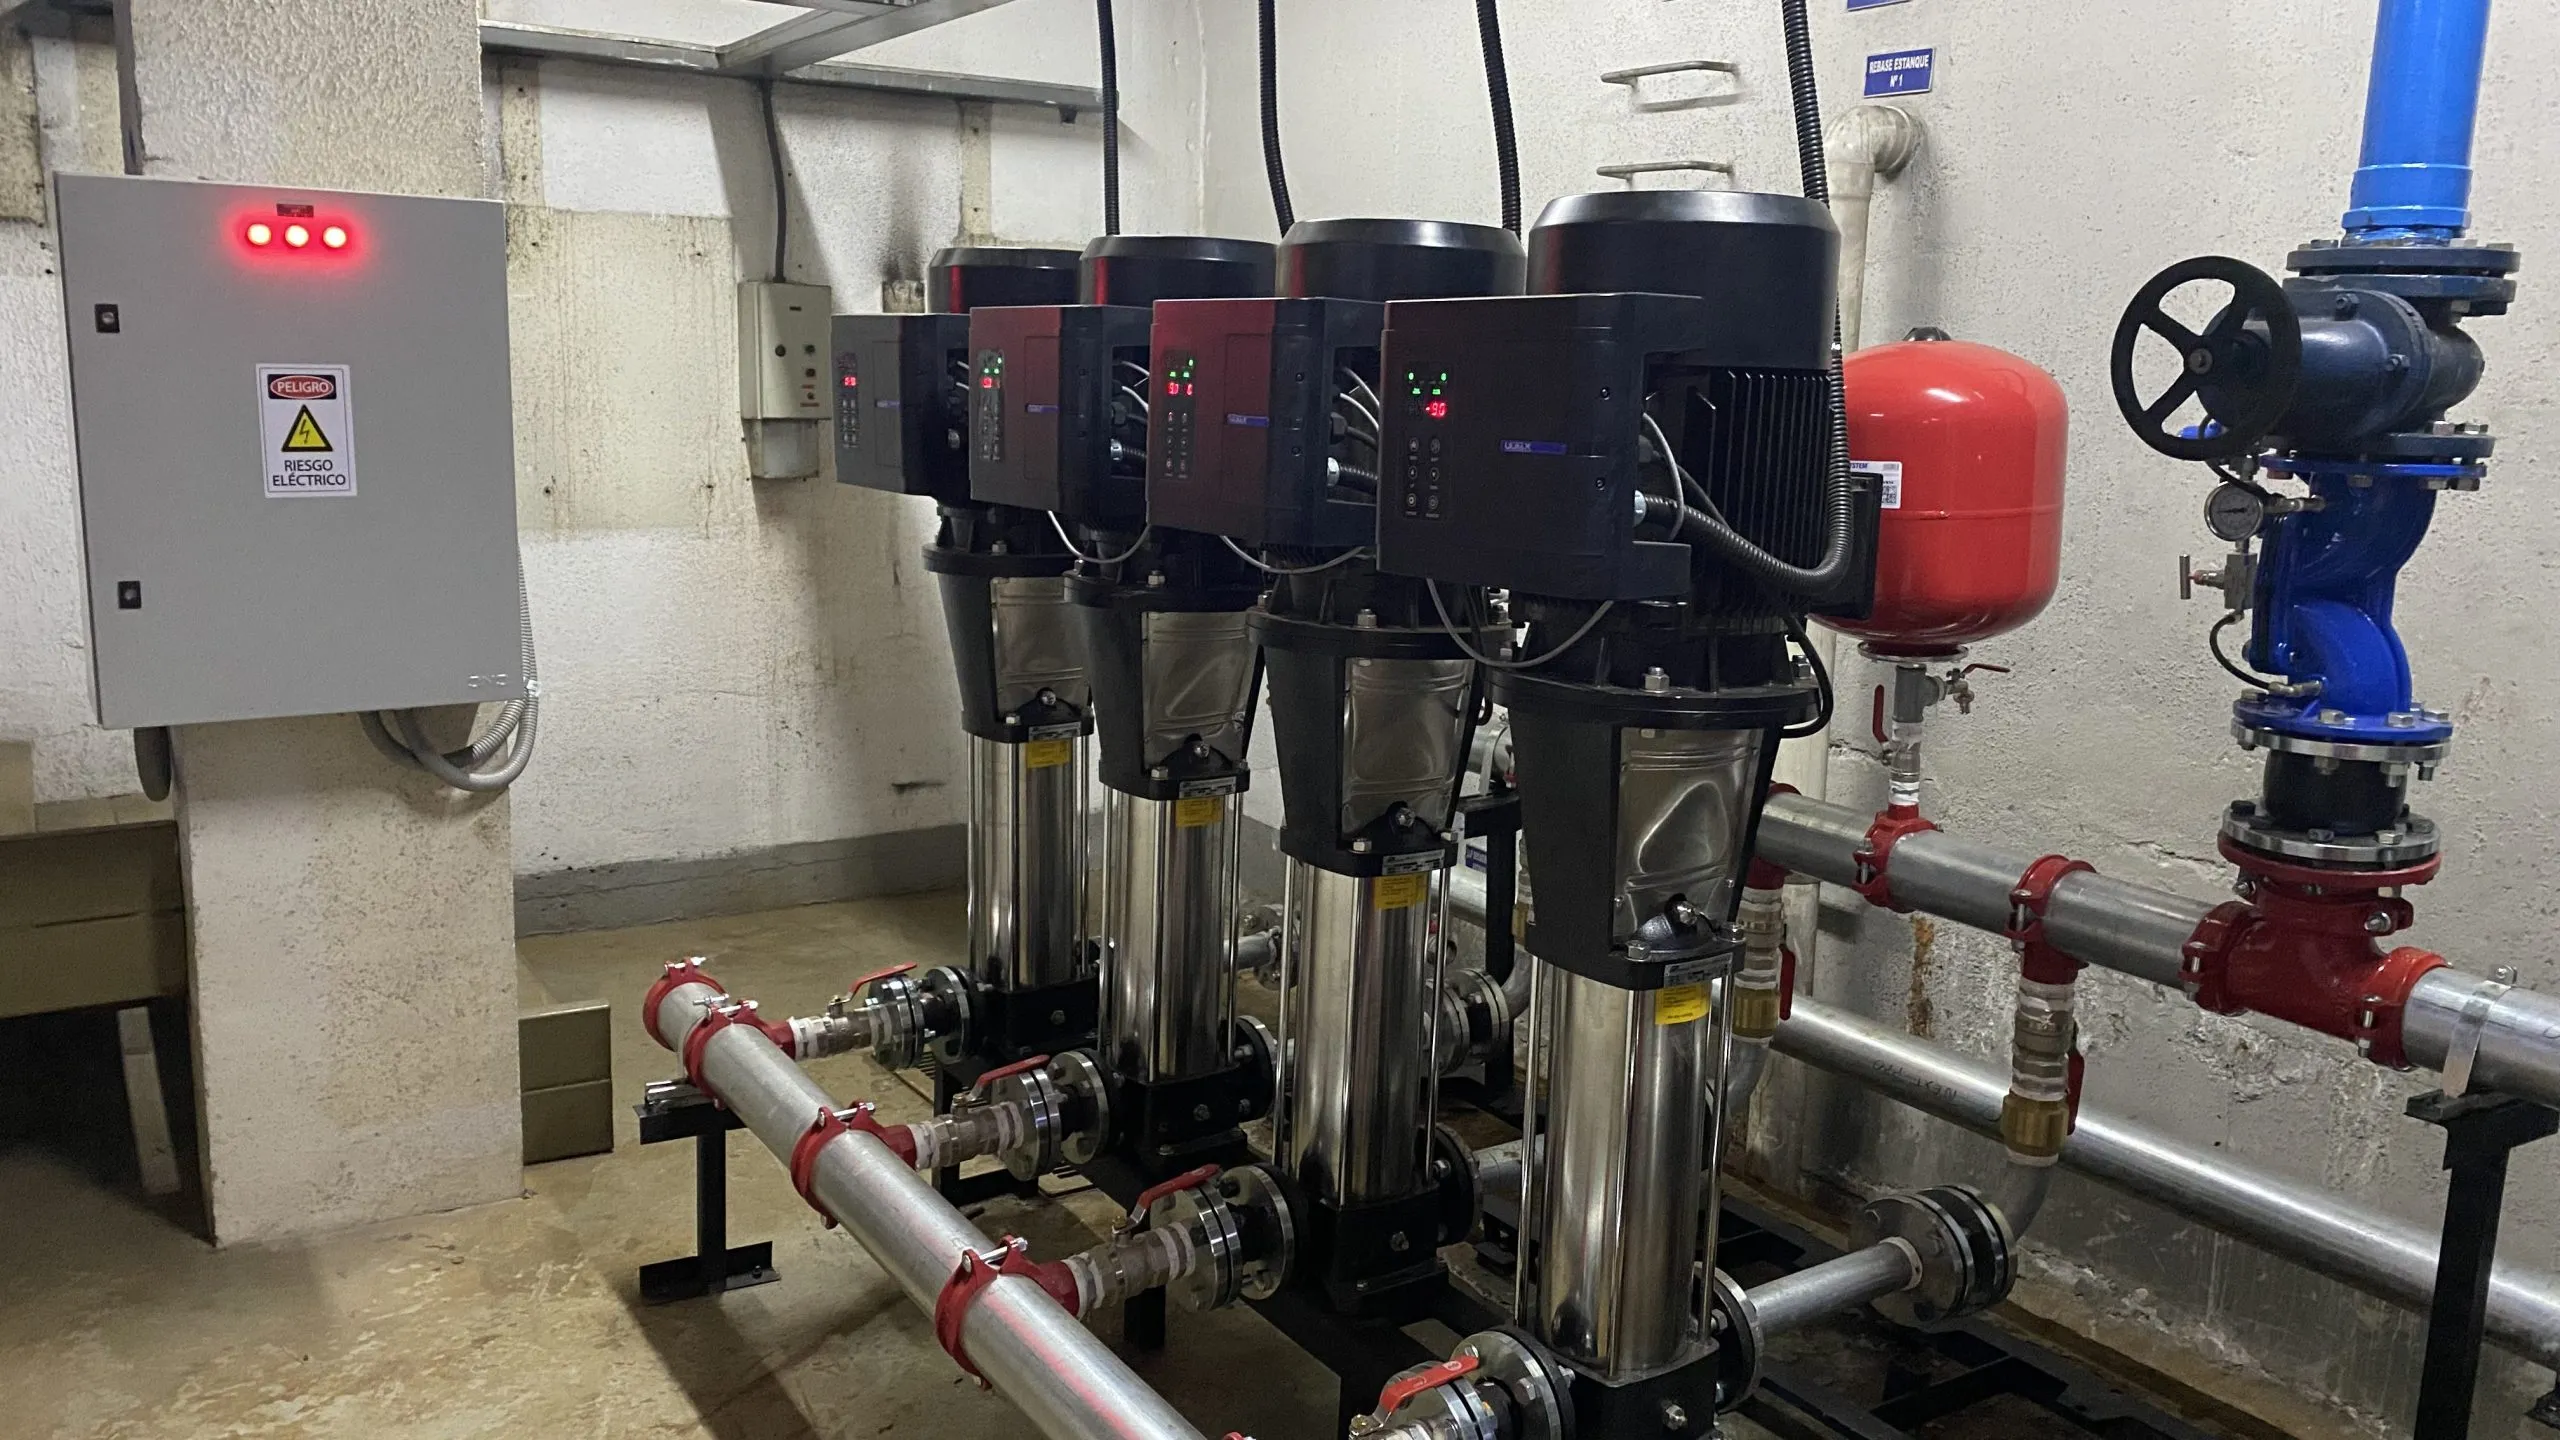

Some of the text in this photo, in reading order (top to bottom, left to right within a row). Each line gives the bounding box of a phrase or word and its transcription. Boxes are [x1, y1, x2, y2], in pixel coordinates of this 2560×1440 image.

[1869, 54, 1930, 74] REBASE ESTANQUE
[277, 381, 329, 393] PELIGRO
[284, 459, 333, 472] RIESGO
[1848, 462, 1868, 470] STEM
[272, 473, 346, 486] ELÉCTRICO
